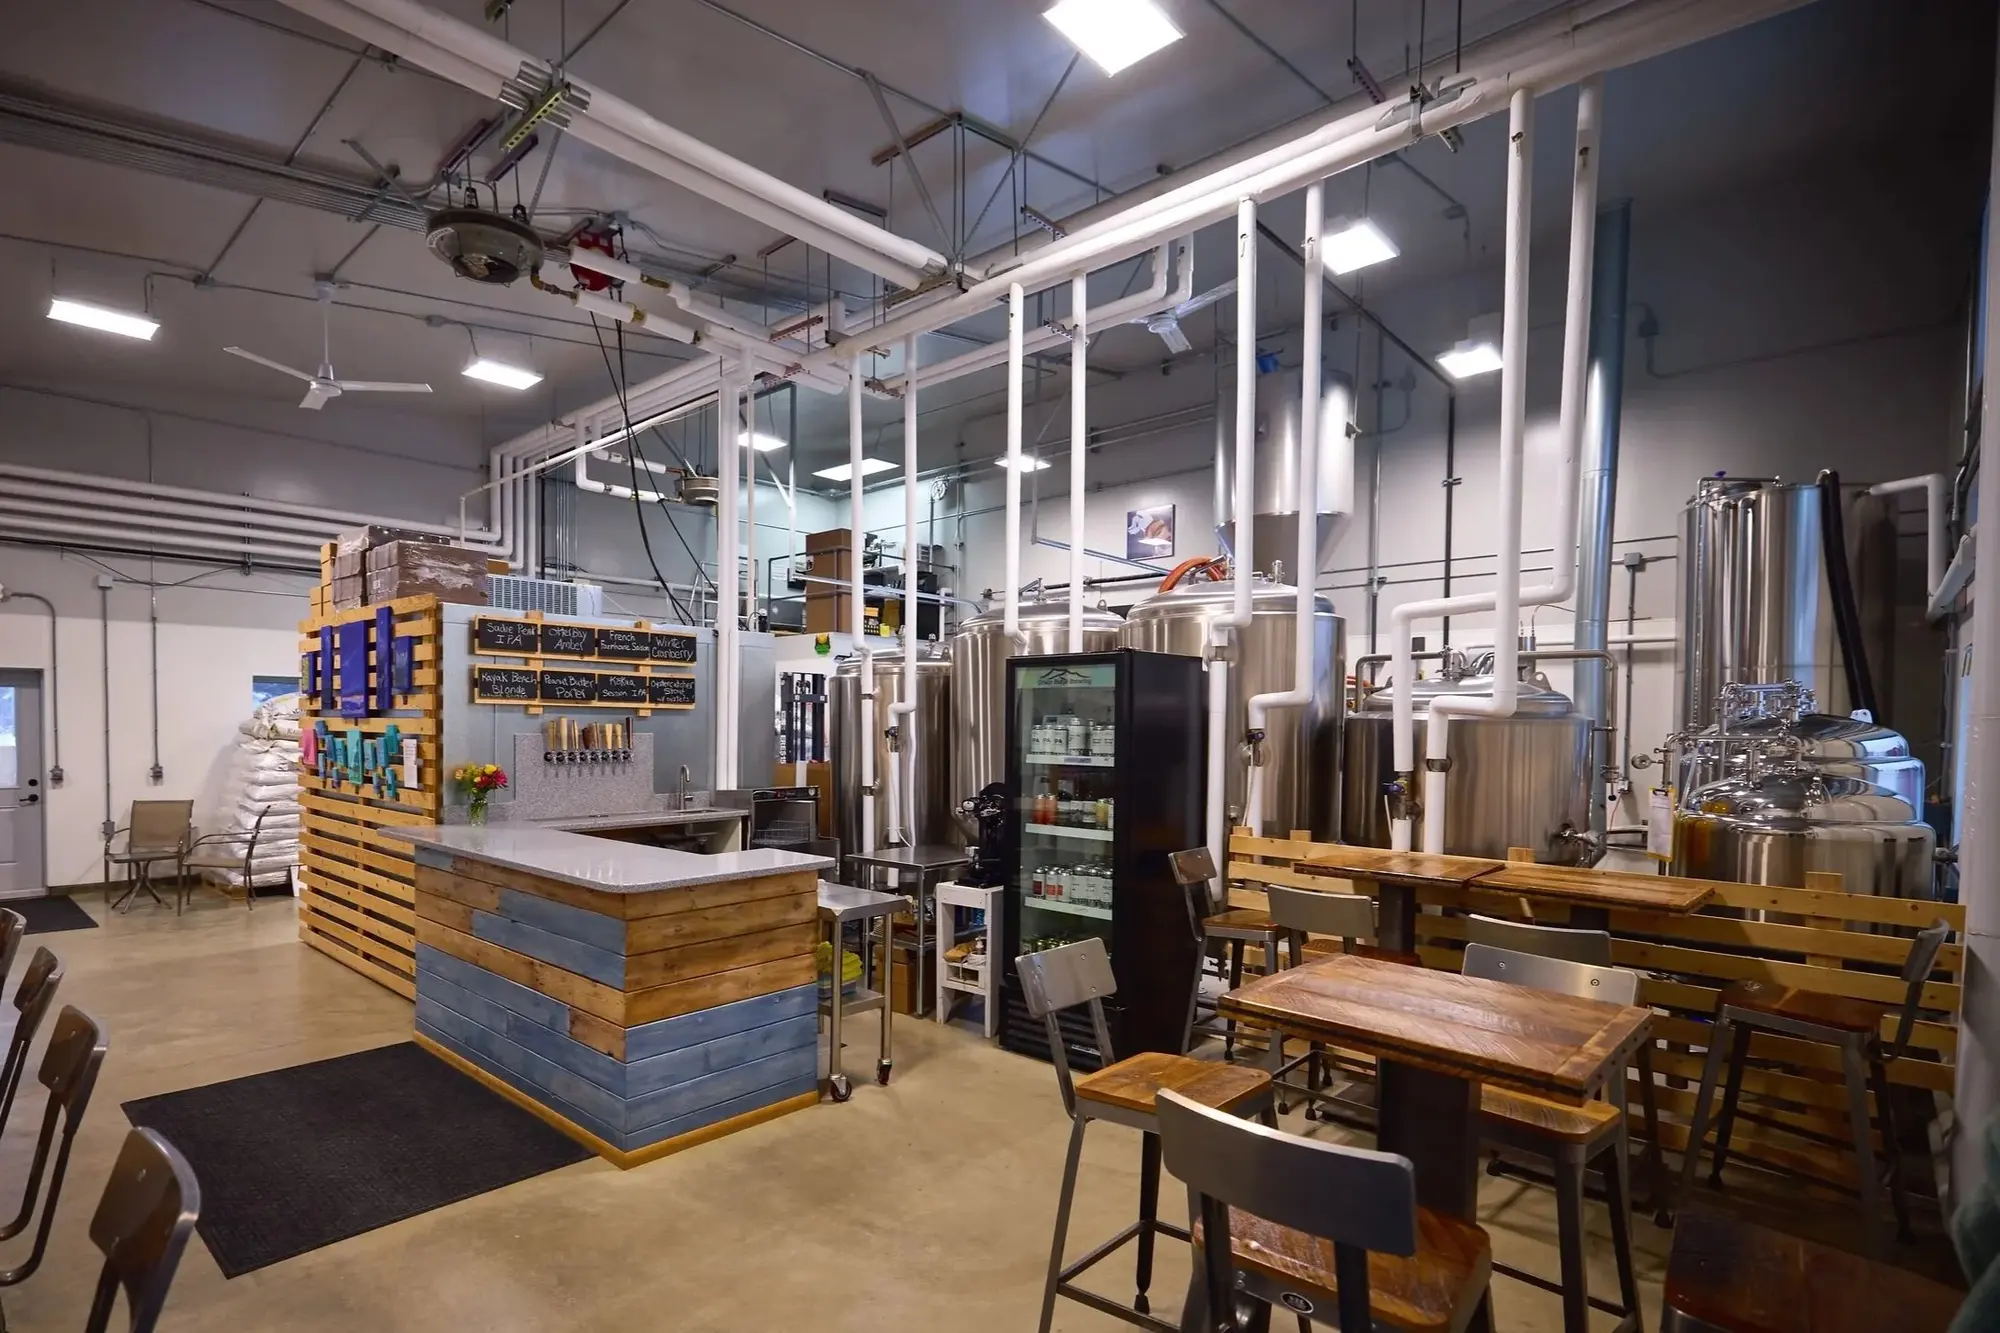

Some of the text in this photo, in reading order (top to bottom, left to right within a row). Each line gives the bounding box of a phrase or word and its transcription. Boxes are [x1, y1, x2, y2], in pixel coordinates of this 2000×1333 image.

[495, 634, 522, 645] IPA
[609, 630, 635, 641] French
[553, 638, 584, 651] Amber
[655, 636, 687, 649] Winter
[651, 646, 695, 662] Cranberry
